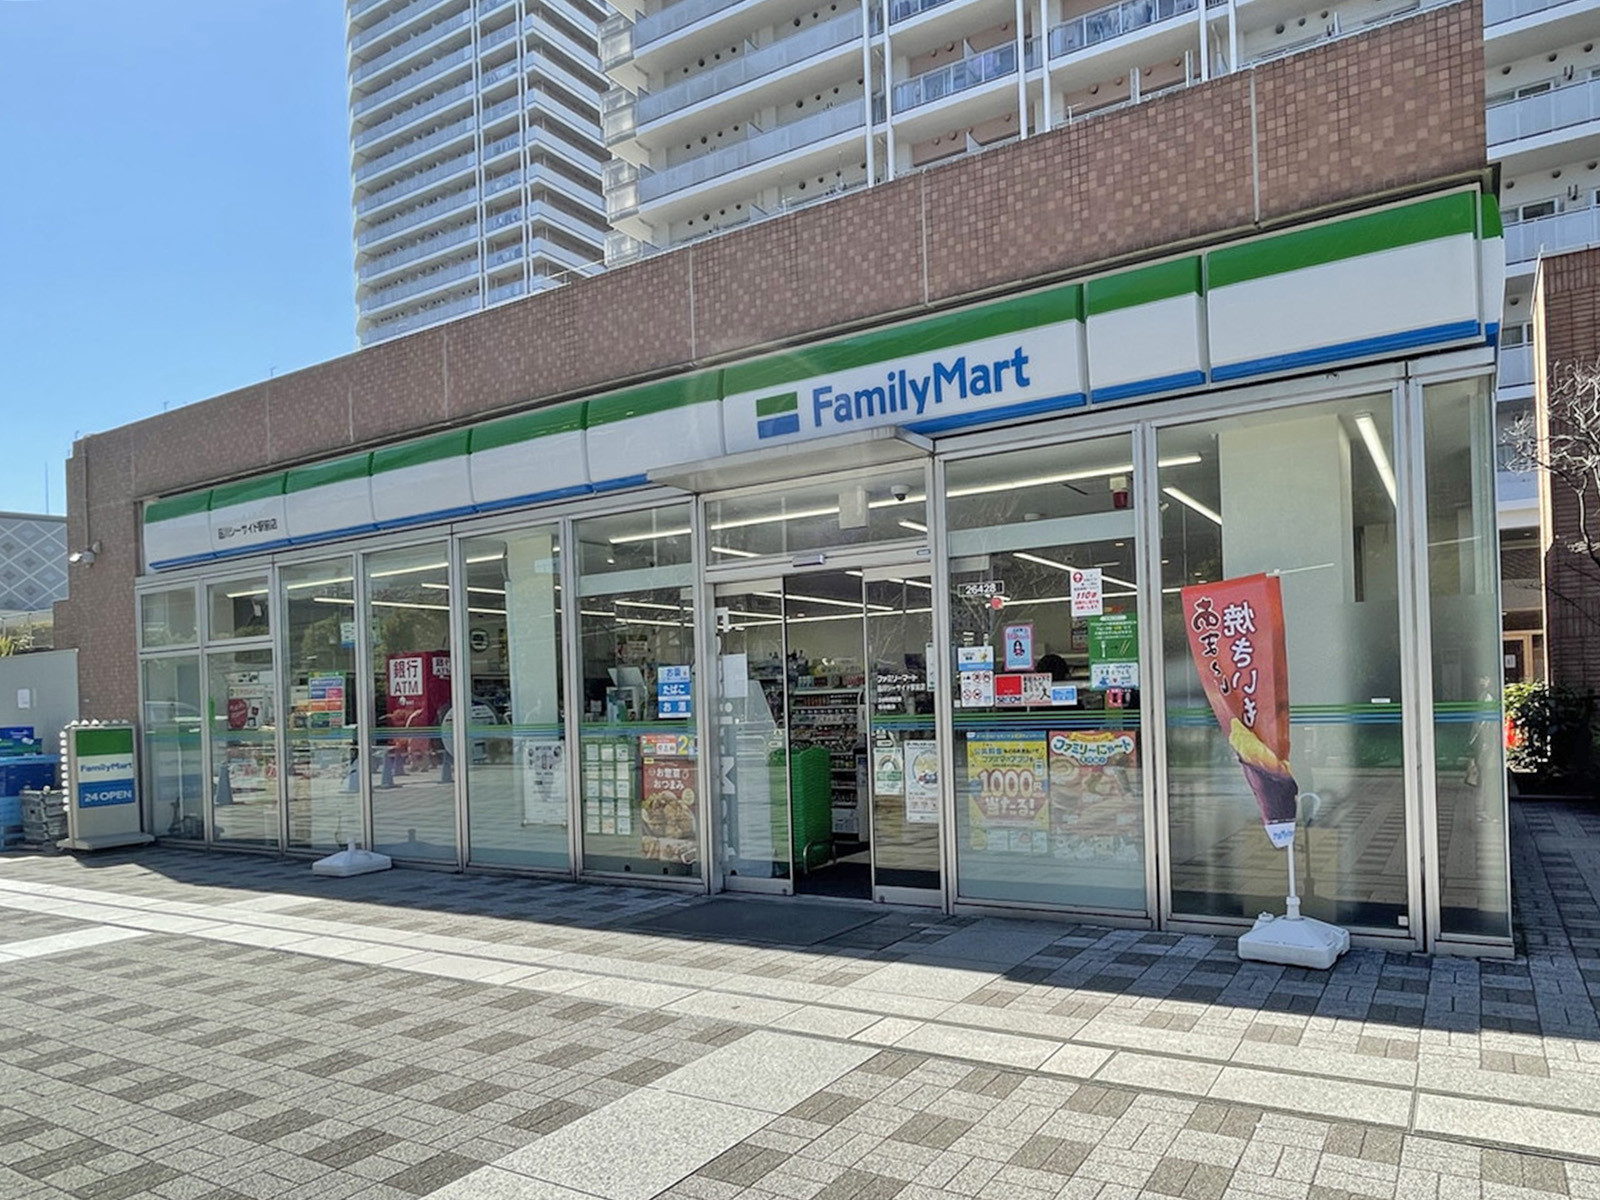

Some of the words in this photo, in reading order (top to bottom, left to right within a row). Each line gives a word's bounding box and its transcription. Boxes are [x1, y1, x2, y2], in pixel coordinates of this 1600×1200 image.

[812, 346, 1031, 428] FamilyMart
[394, 660, 419, 679] 銀行
[394, 680, 419, 695] ATM
[662, 684, 686, 696] たばこ
[80, 762, 133, 773] FamilyMart
[84, 792, 99, 803] 24
[99, 790, 133, 801] OPEN
